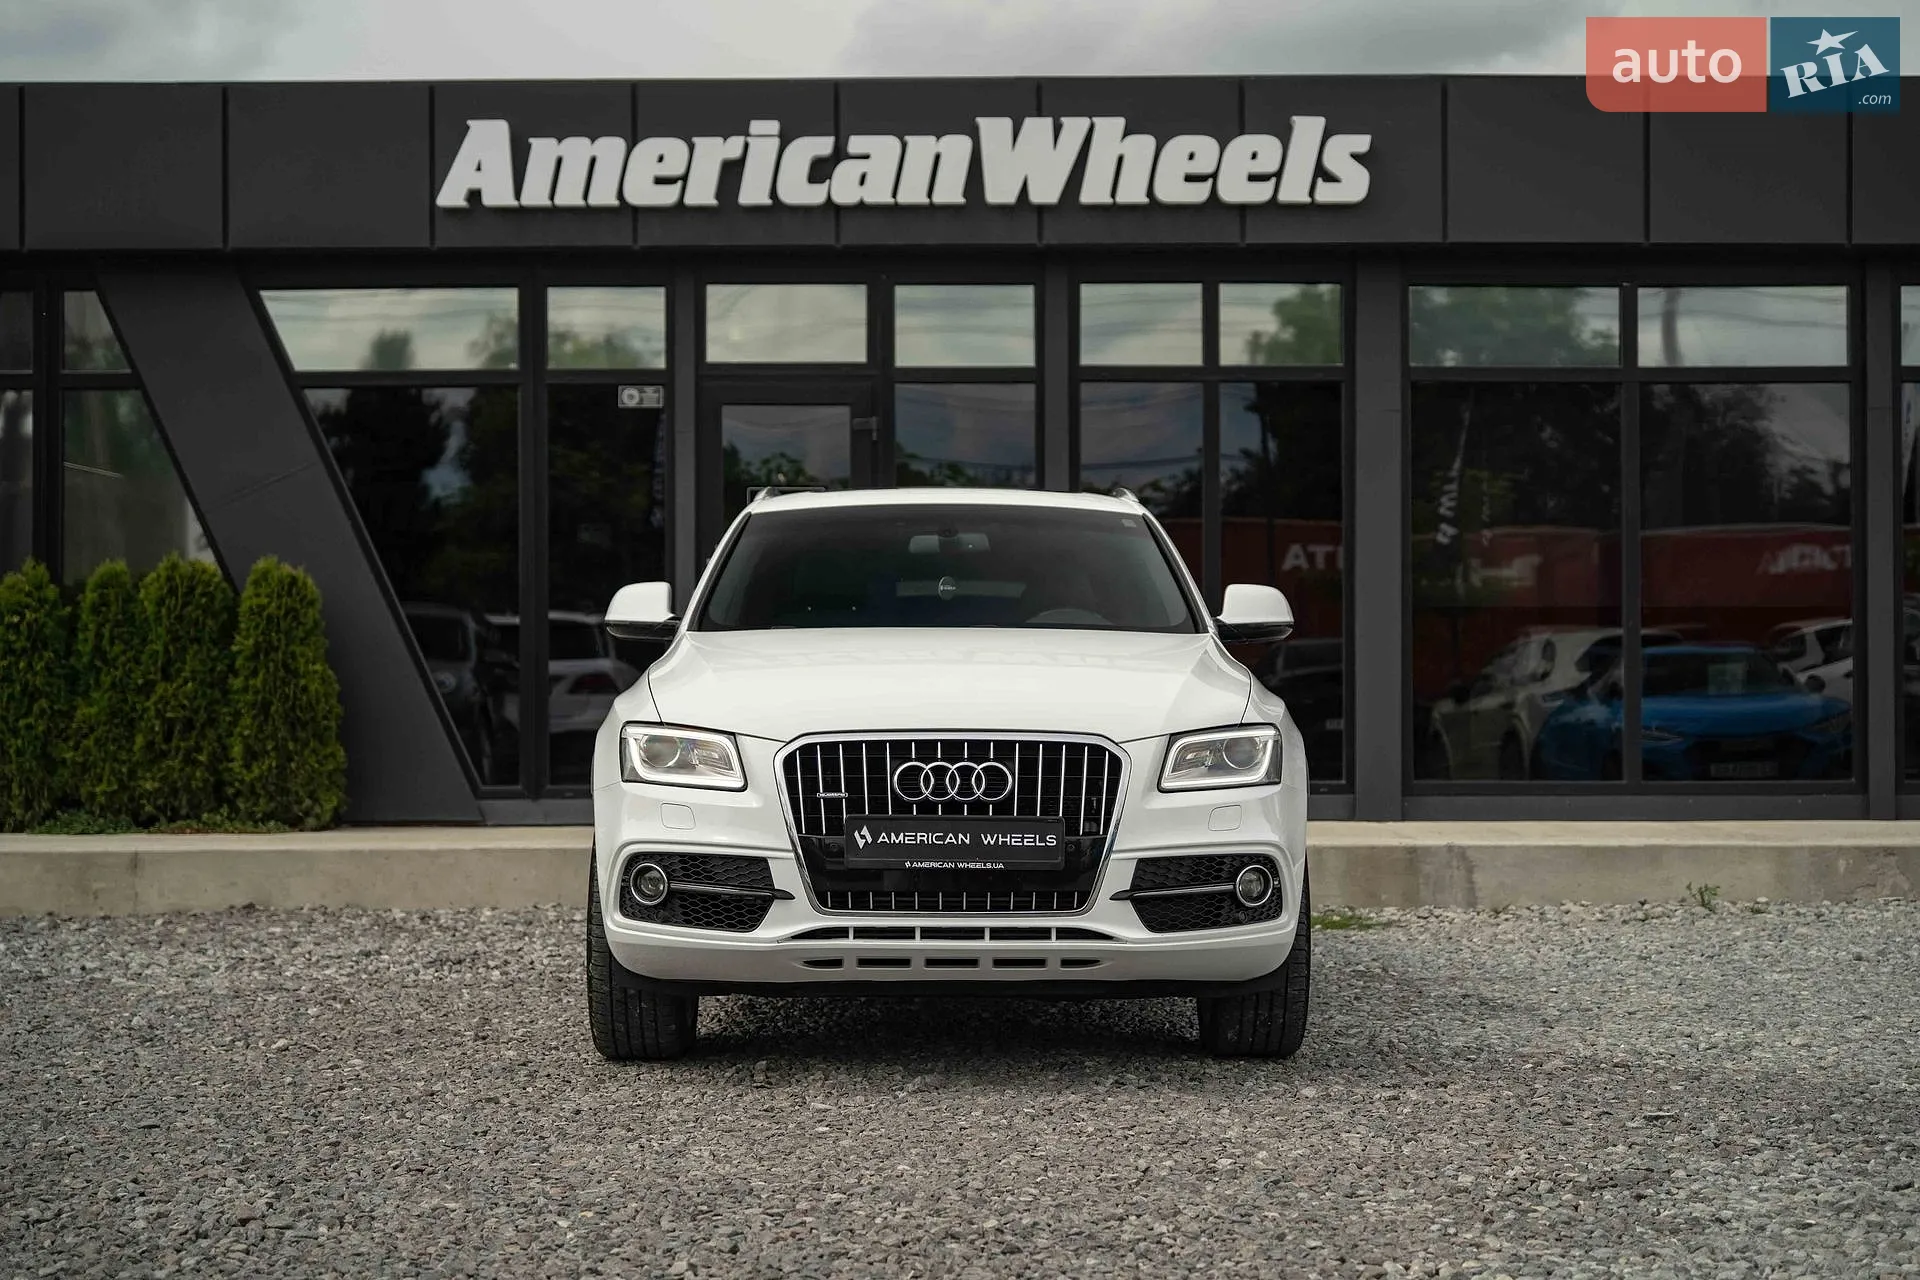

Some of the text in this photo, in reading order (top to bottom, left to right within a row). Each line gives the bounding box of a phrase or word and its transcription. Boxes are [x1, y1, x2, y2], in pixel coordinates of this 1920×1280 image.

[436, 115, 1372, 208] AmericanWheels
[877, 832, 1057, 847] AMERICAN WHEELS
[912, 861, 1005, 869] AMERICAN WHEELS.UA
